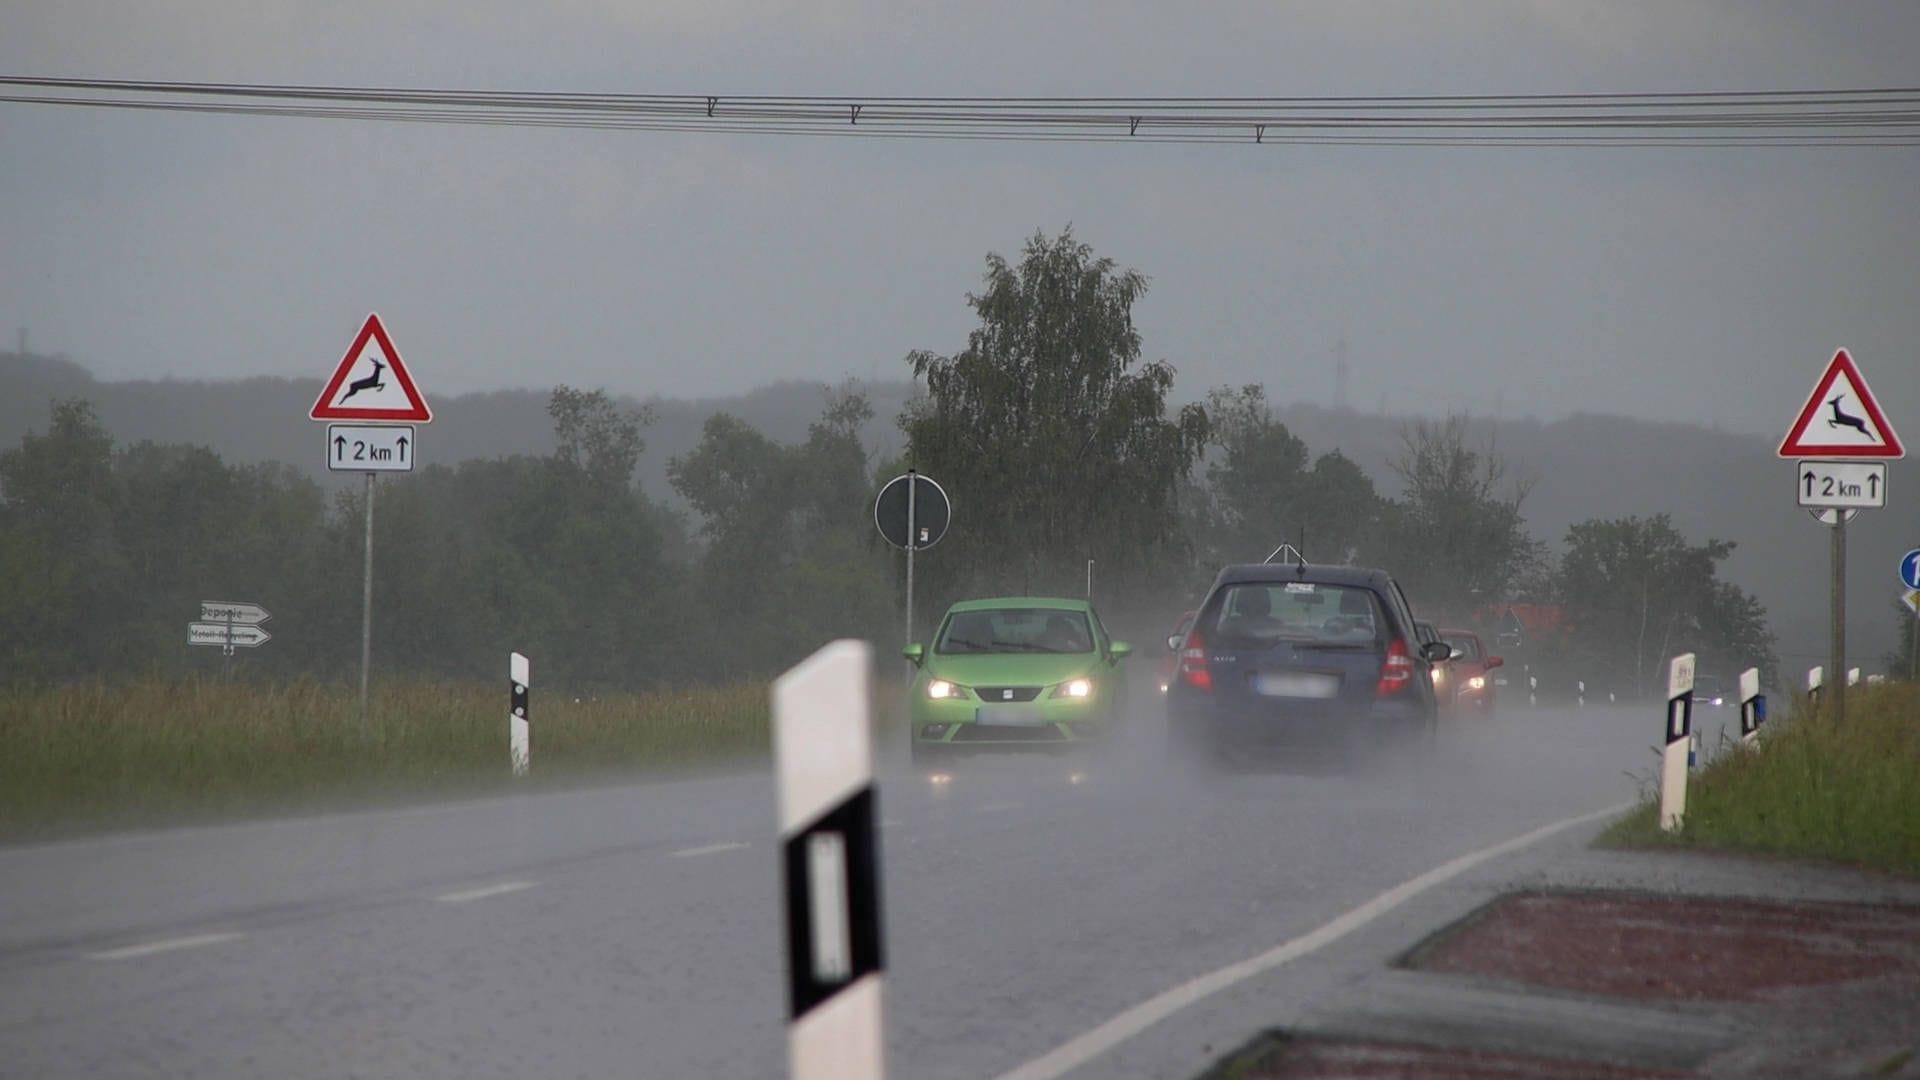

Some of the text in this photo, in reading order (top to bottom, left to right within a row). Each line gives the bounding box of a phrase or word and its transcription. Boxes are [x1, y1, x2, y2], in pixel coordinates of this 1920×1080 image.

[354, 440, 391, 460] 2 km
[1822, 476, 1861, 496] 2 km
